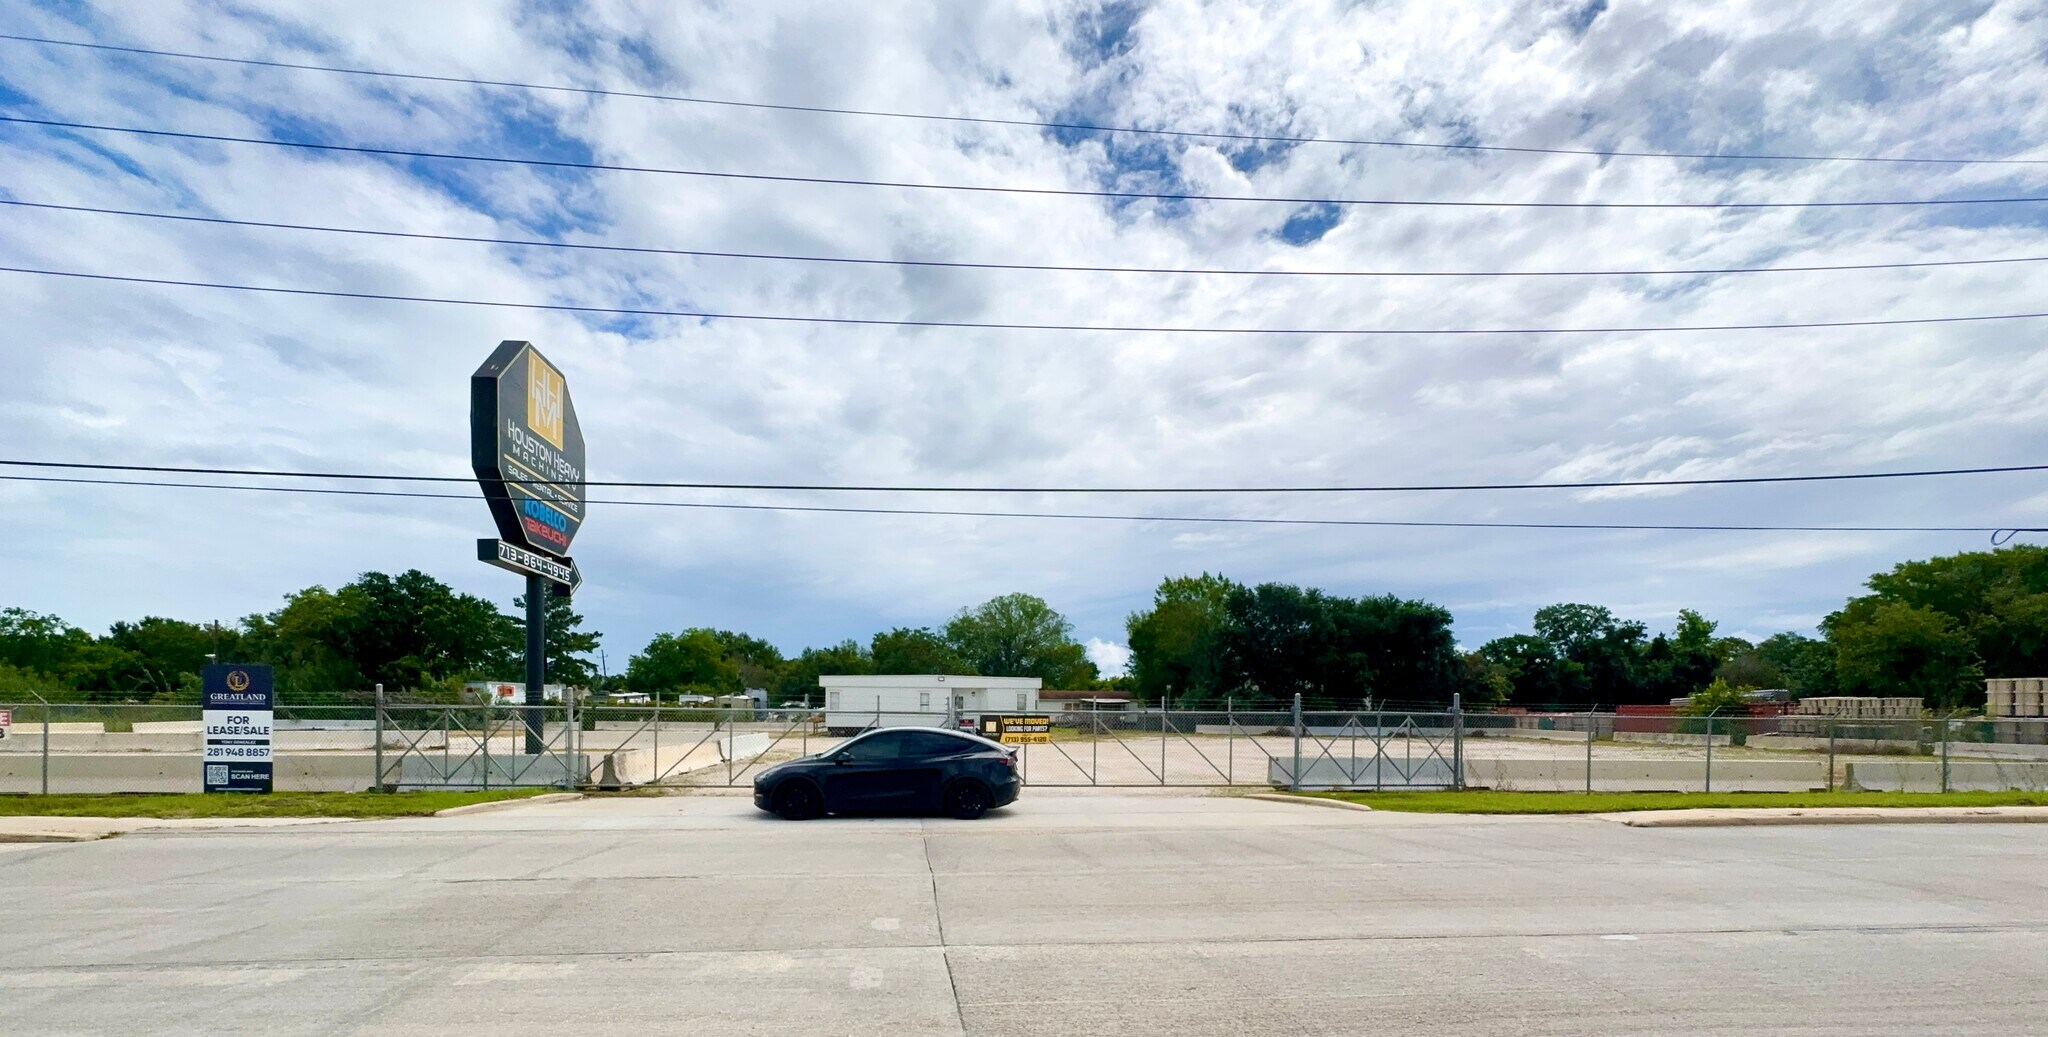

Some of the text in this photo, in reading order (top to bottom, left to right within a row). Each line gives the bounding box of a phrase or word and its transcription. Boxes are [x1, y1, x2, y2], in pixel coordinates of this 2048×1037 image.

[508, 418, 580, 482] HOUSTON HEAVY
[508, 465, 528, 481] SALES
[512, 443, 577, 491] MACHINERY
[524, 495, 567, 532] KOBELCO
[525, 516, 567, 547] TAKEUCHI
[500, 545, 570, 581] 713-864-4945
[207, 726, 270, 735] LEASE/SALE
[227, 716, 250, 724] FOR
[207, 748, 270, 757] 281 948 8857
